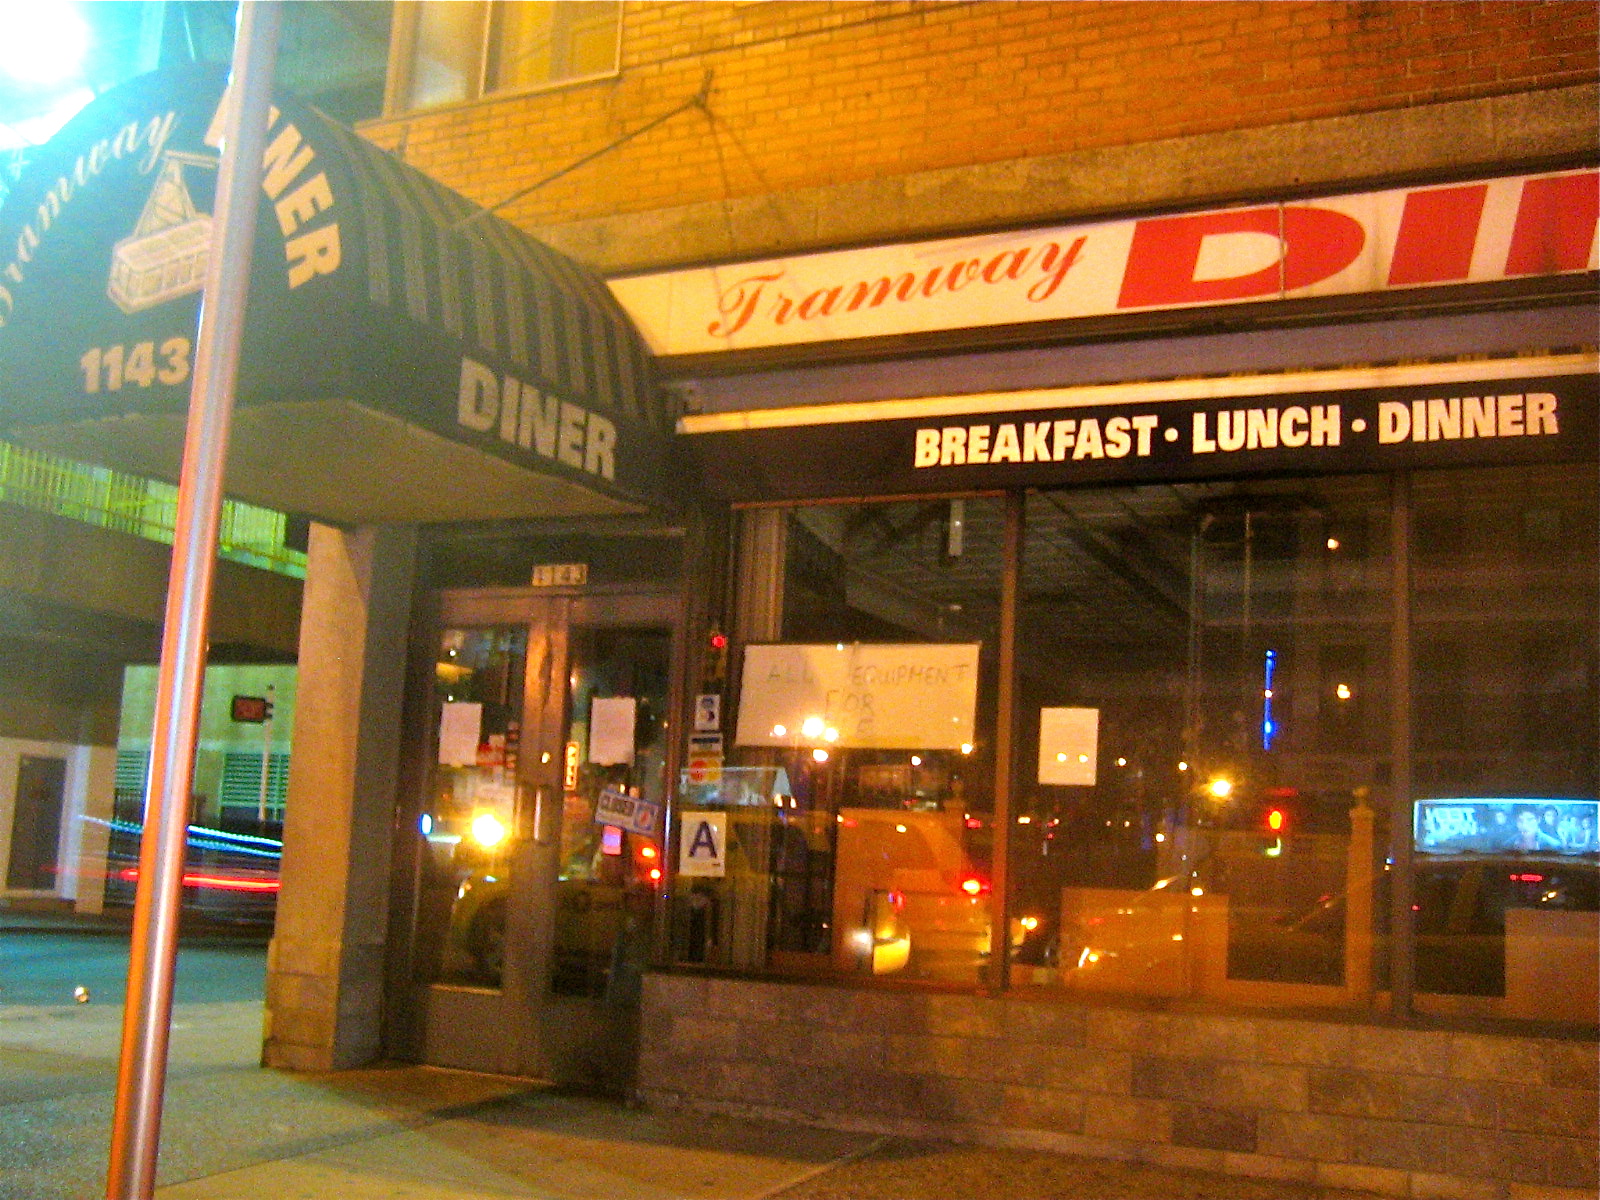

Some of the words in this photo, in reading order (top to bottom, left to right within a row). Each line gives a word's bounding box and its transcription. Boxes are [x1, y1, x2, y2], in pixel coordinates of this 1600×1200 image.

[204, 84, 342, 290] NER
[708, 237, 1090, 337] Tramway
[80, 337, 191, 393] 1143
[457, 357, 617, 481] DINER
[914, 413, 1159, 467] BREAKFAST
[1191, 404, 1342, 455] LUNCH
[1378, 392, 1560, 445] DINNER
[852, 663, 971, 688] EQUIPMENT
[688, 820, 717, 858] A
